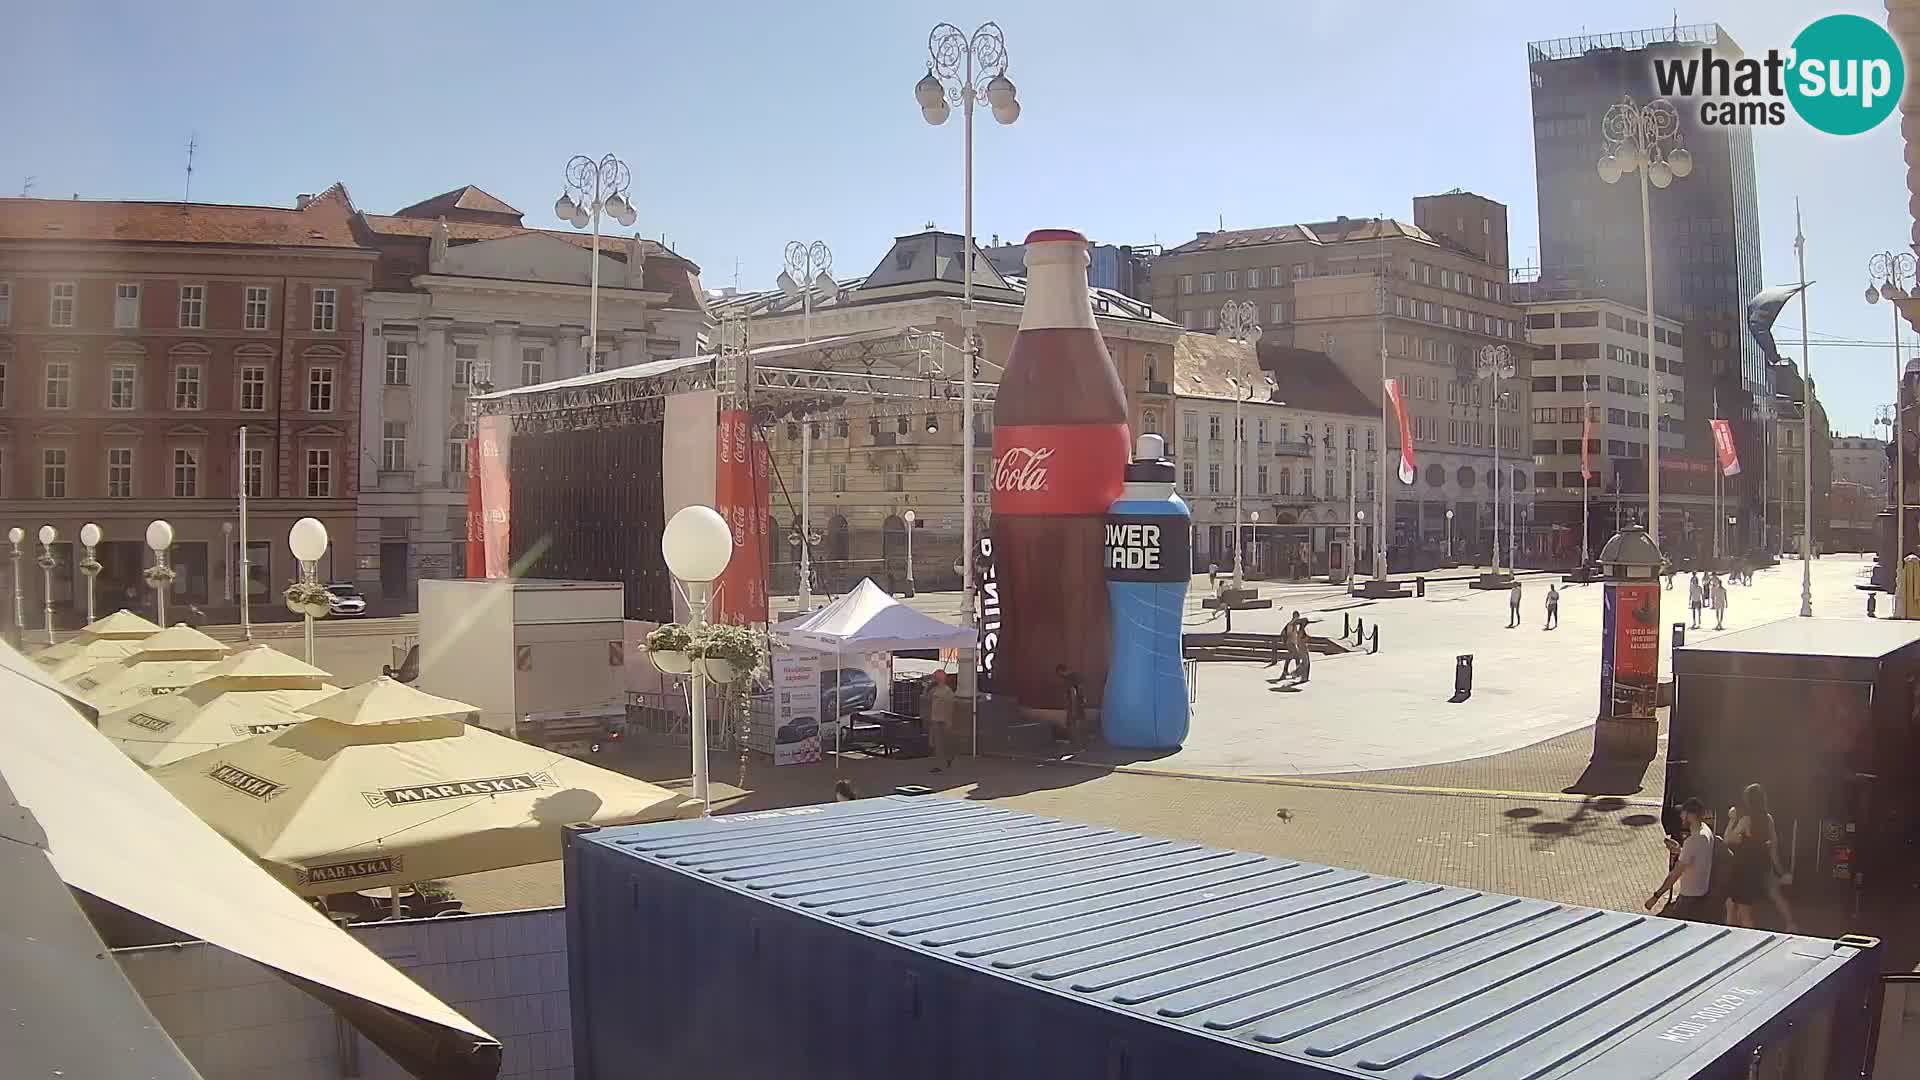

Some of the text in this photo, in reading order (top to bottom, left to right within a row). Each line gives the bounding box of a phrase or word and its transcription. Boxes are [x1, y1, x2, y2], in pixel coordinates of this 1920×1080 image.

[1105, 547, 1160, 569] ADE
[393, 777, 531, 803] MARASKA
[312, 860, 389, 881] MARASKA
[1690, 994, 1745, 1022] 300629
